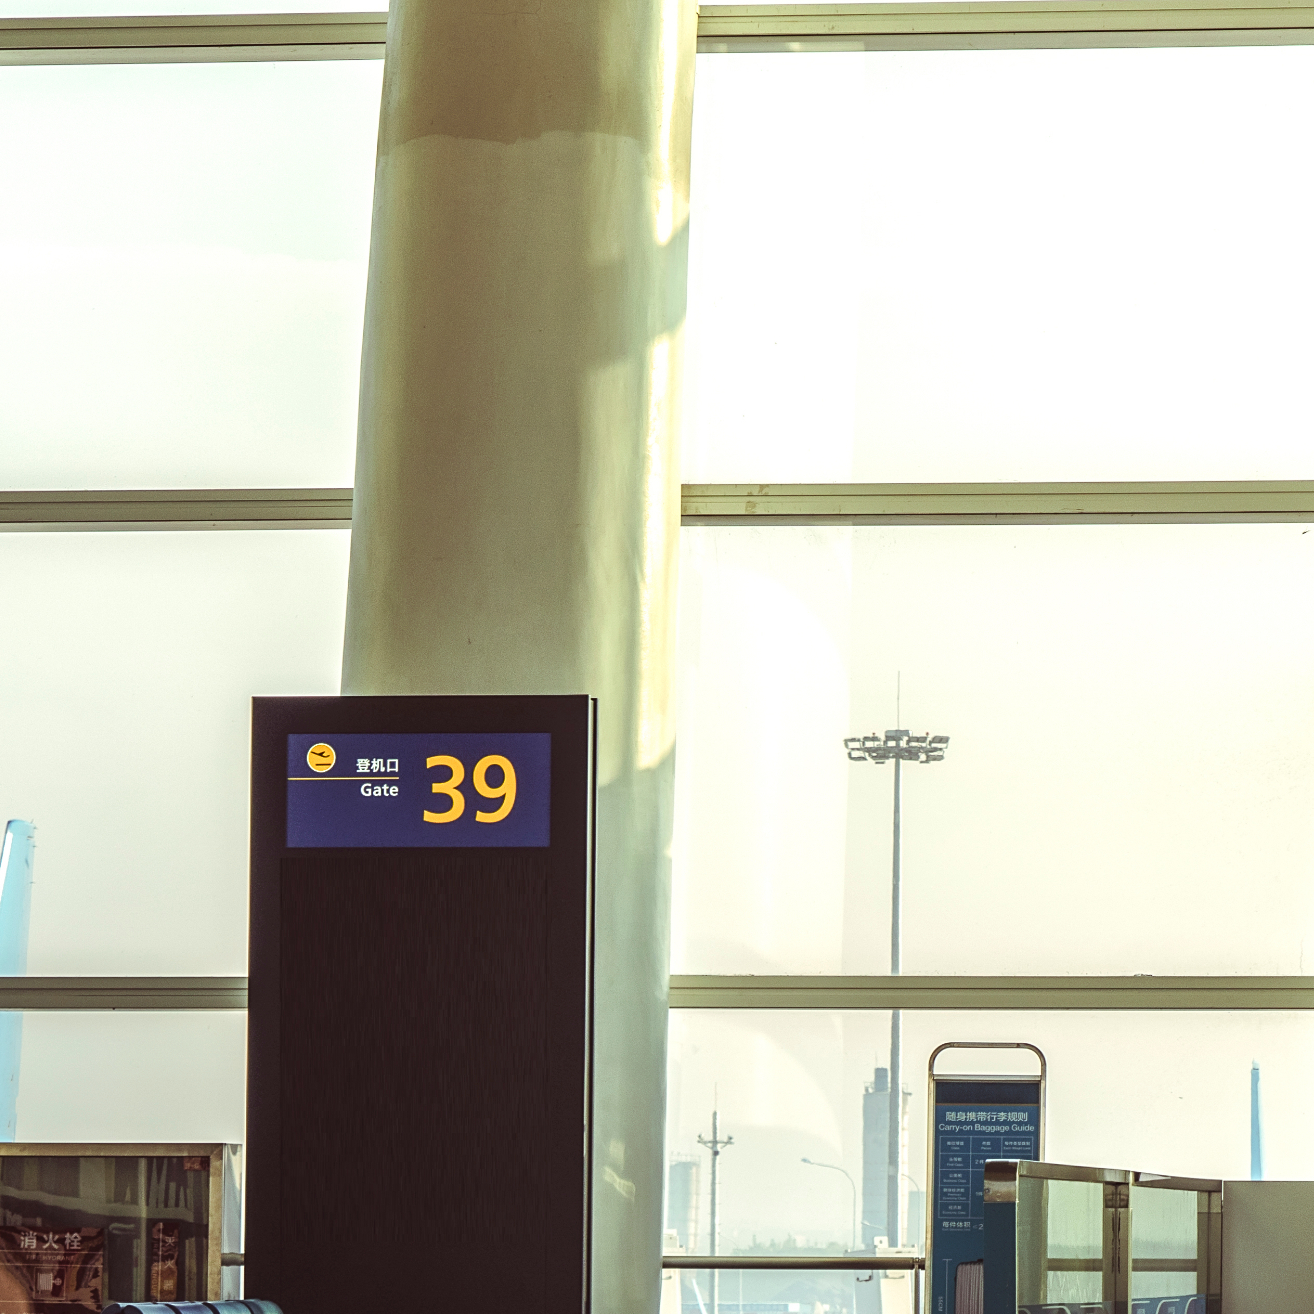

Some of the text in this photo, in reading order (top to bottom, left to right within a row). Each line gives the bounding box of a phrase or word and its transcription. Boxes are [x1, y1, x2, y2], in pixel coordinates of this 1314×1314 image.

[356, 757, 399, 773] 登机口
[360, 782, 399, 797] Gate
[423, 754, 517, 824] 39
[945, 1111, 1028, 1122] 随身携带行李规则
[938, 1123, 1035, 1133] Carry-on Baggage Guide
[20, 1231, 82, 1250] 消火栓
